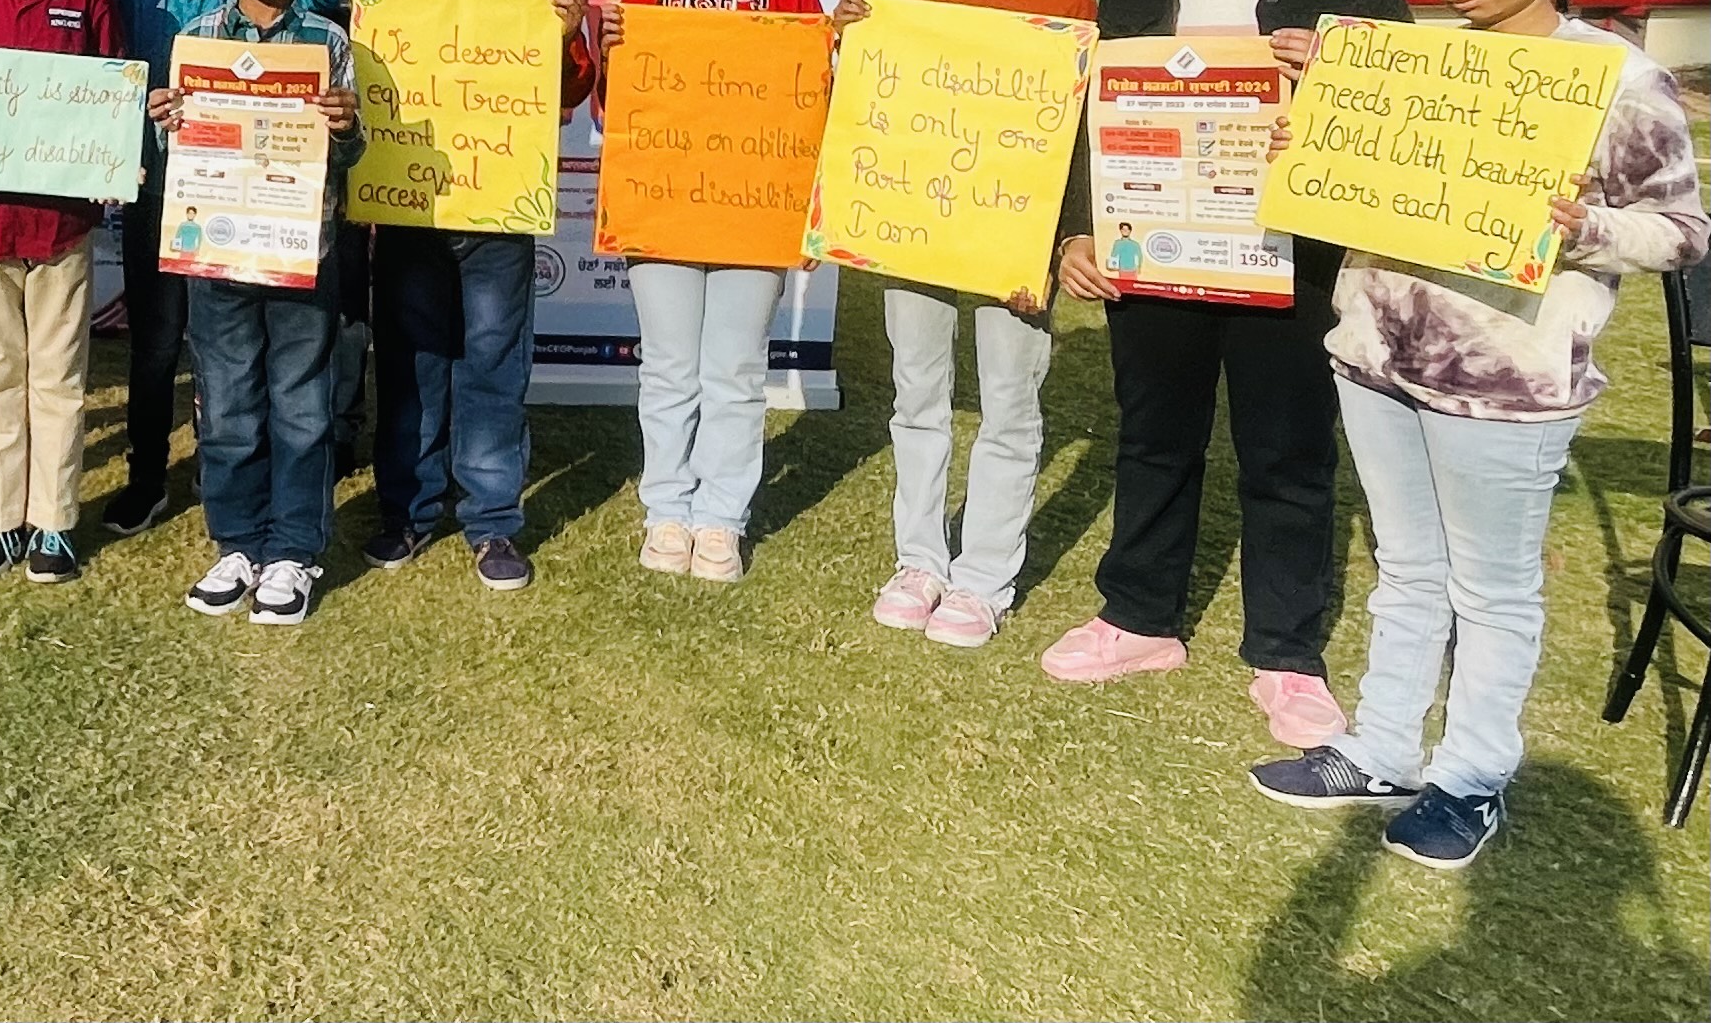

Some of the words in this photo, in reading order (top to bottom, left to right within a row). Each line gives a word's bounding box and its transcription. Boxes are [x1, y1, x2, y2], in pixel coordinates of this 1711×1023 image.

[371, 28, 418, 65] We
[439, 24, 543, 67] deserve
[1320, 24, 1429, 76] Children
[1504, 48, 1609, 111] Special
[37, 77, 62, 102] is
[286, 83, 314, 94] 2024
[367, 75, 442, 120] equal
[455, 78, 547, 117] Treat
[699, 60, 768, 102] time
[859, 49, 900, 99] My
[922, 54, 1069, 133] disability
[1234, 81, 1271, 93] 2024
[1313, 79, 1391, 117] needs
[1395, 94, 1483, 139] paint
[1492, 100, 1539, 142] the
[451, 126, 514, 157] and
[628, 109, 693, 156] Focus
[706, 132, 733, 153] on
[741, 125, 819, 162] abilities
[856, 102, 890, 136] is
[910, 107, 981, 173] only
[1301, 113, 1381, 162] World
[1461, 139, 1566, 198] beautiful
[24, 133, 125, 183] disability
[407, 156, 482, 195] equal
[358, 182, 430, 211] access
[626, 174, 674, 200] not
[851, 146, 912, 195] Part
[926, 174, 958, 218] of
[845, 199, 875, 238] I
[876, 223, 928, 245] am
[1287, 162, 1380, 209] Colors
[1392, 182, 1450, 226] each
[1464, 200, 1524, 271] day
[279, 237, 308, 250] 1950
[1240, 253, 1278, 267] 1950
